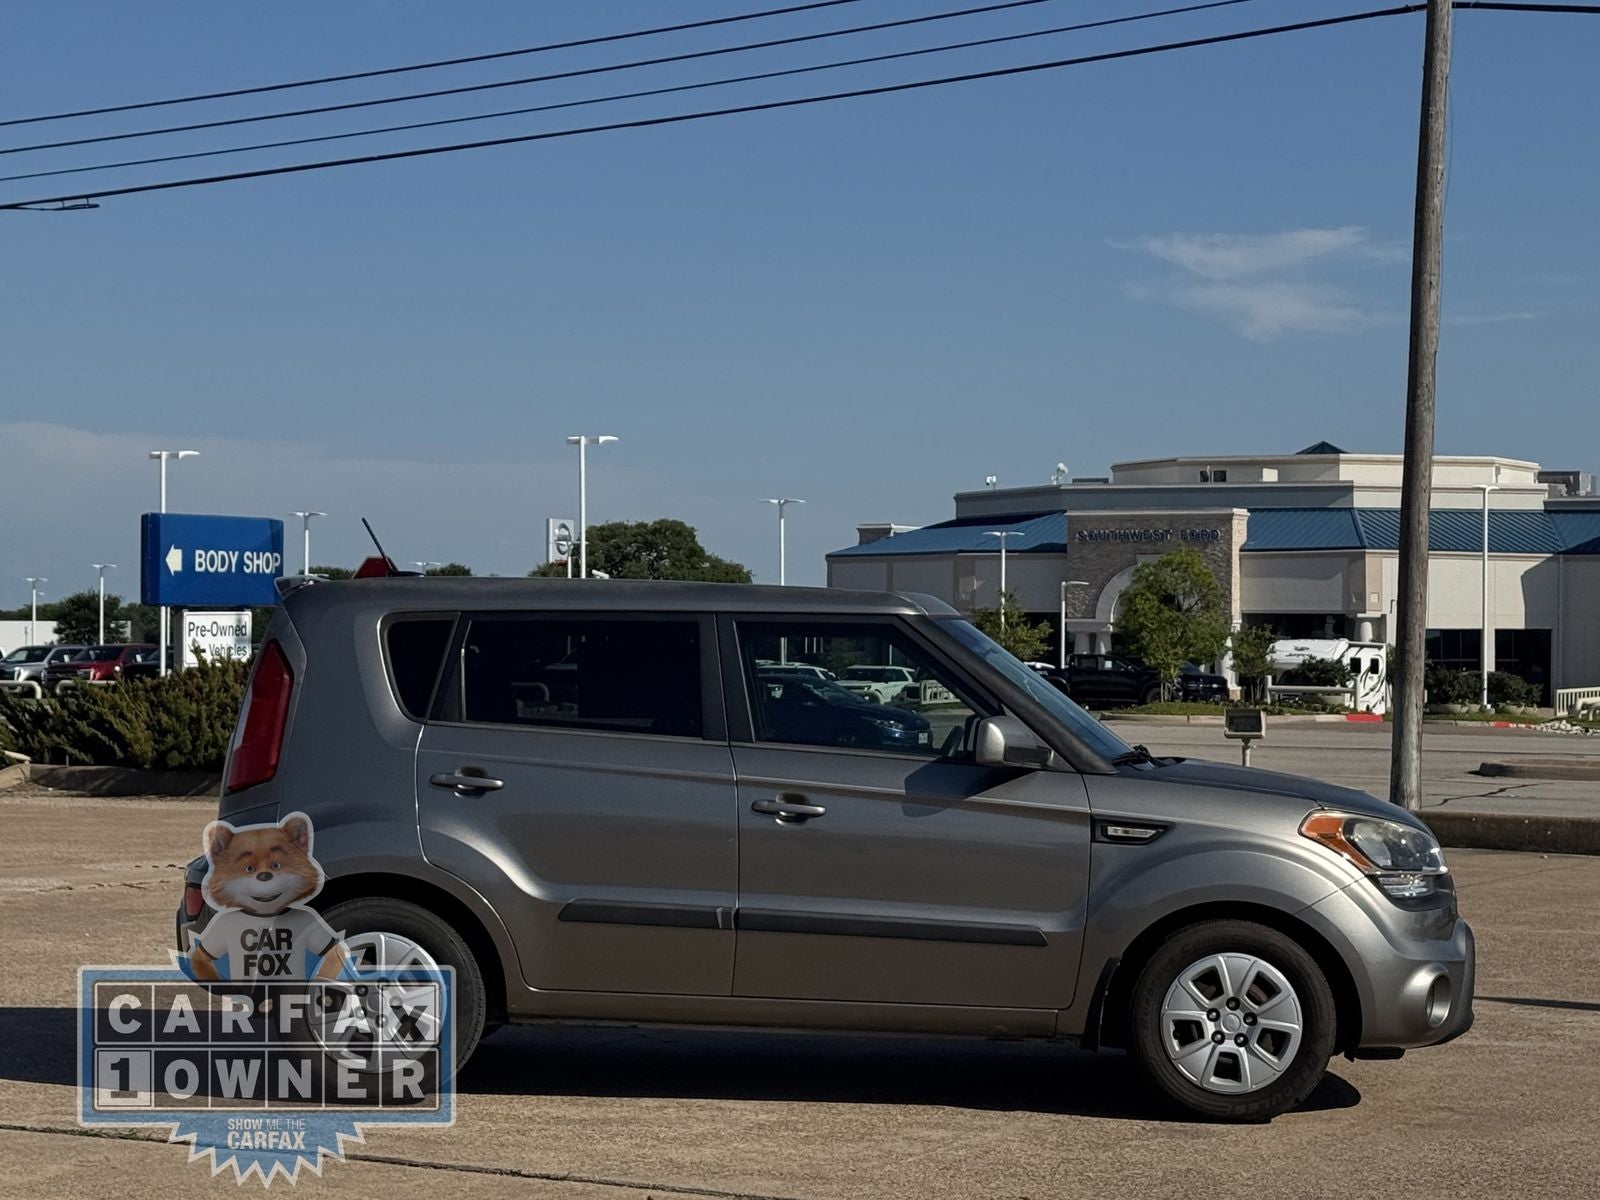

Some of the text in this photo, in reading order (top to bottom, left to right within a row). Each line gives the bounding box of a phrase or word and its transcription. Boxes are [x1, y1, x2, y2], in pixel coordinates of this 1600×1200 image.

[1075, 529, 1221, 543] SOUTHWEST FORD
[194, 549, 281, 574] BODY SHOP
[188, 621, 247, 637] Pre-Owned
[208, 643, 247, 657] Vehicles
